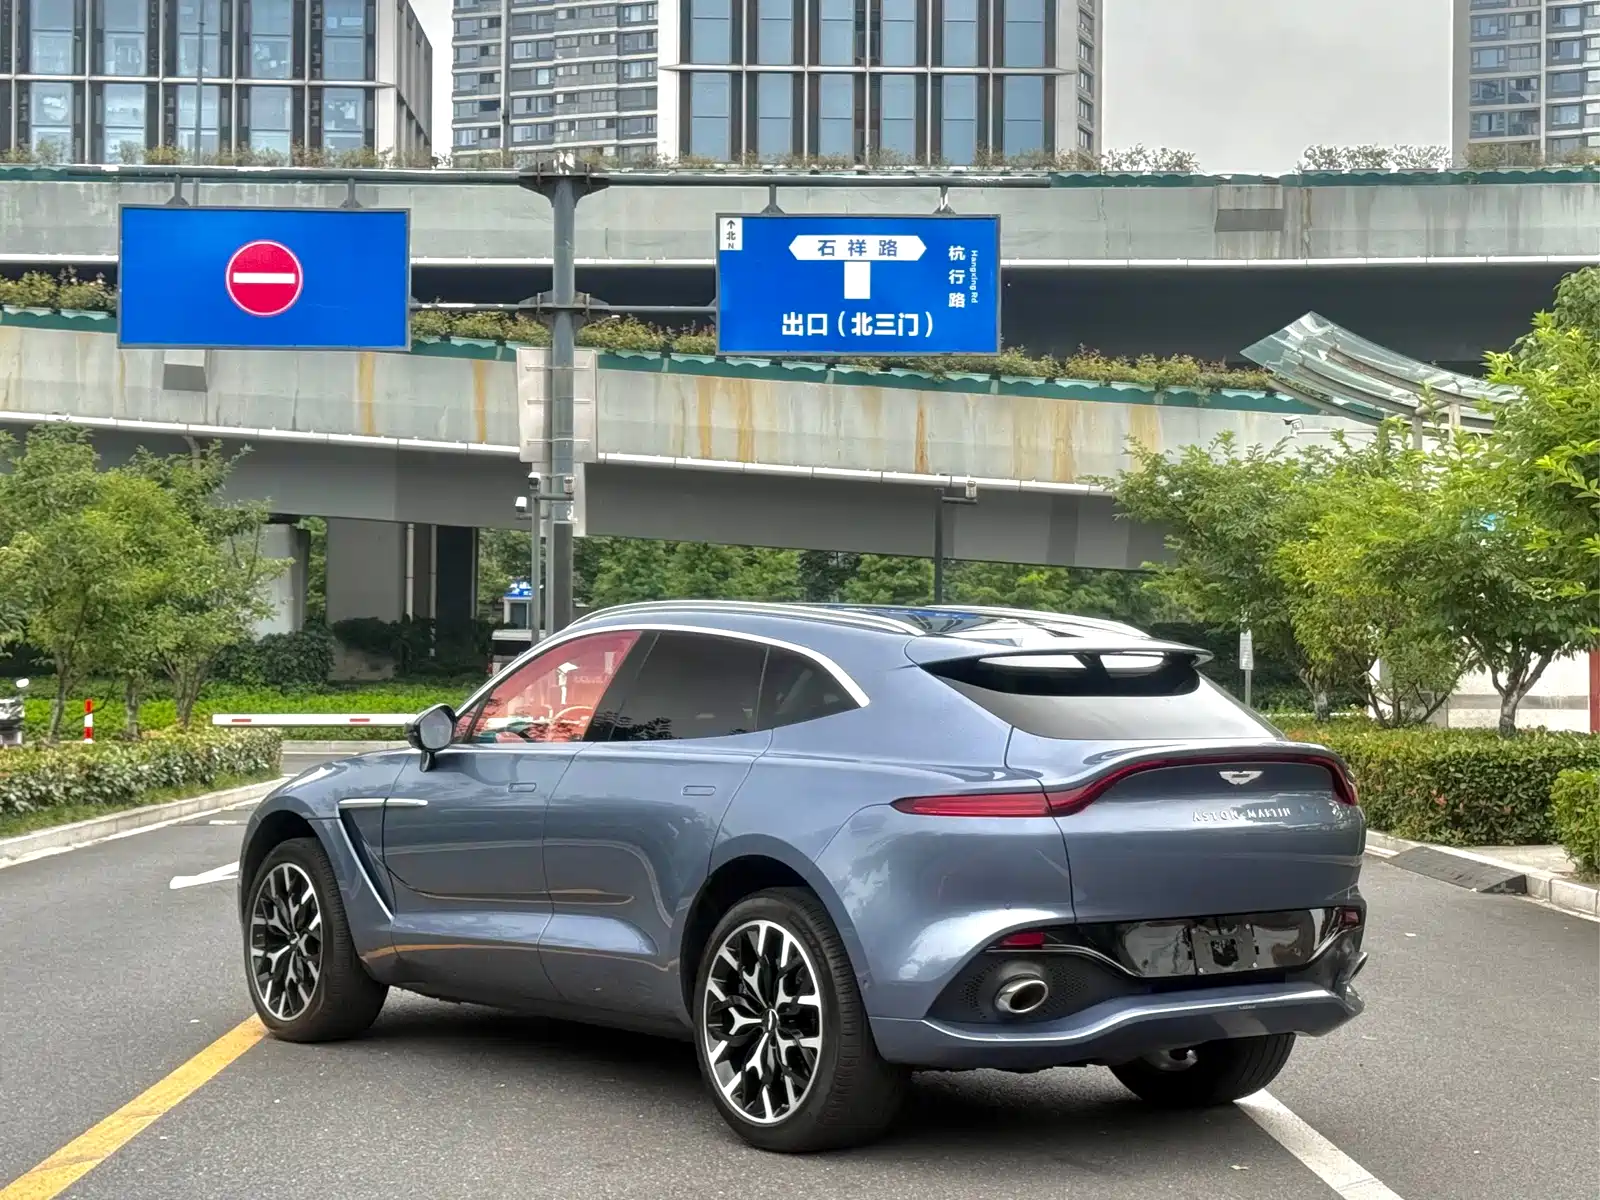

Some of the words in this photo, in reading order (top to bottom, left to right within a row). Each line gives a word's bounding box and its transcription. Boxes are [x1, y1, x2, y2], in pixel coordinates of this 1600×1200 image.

[726, 231, 736, 240] 北
[817, 239, 898, 257] 石祥路
[948, 245, 966, 308] 杭行路
[970, 250, 979, 290] Hangxing
[971, 292, 979, 304] Rd
[1193, 810, 1240, 821] ASTON
